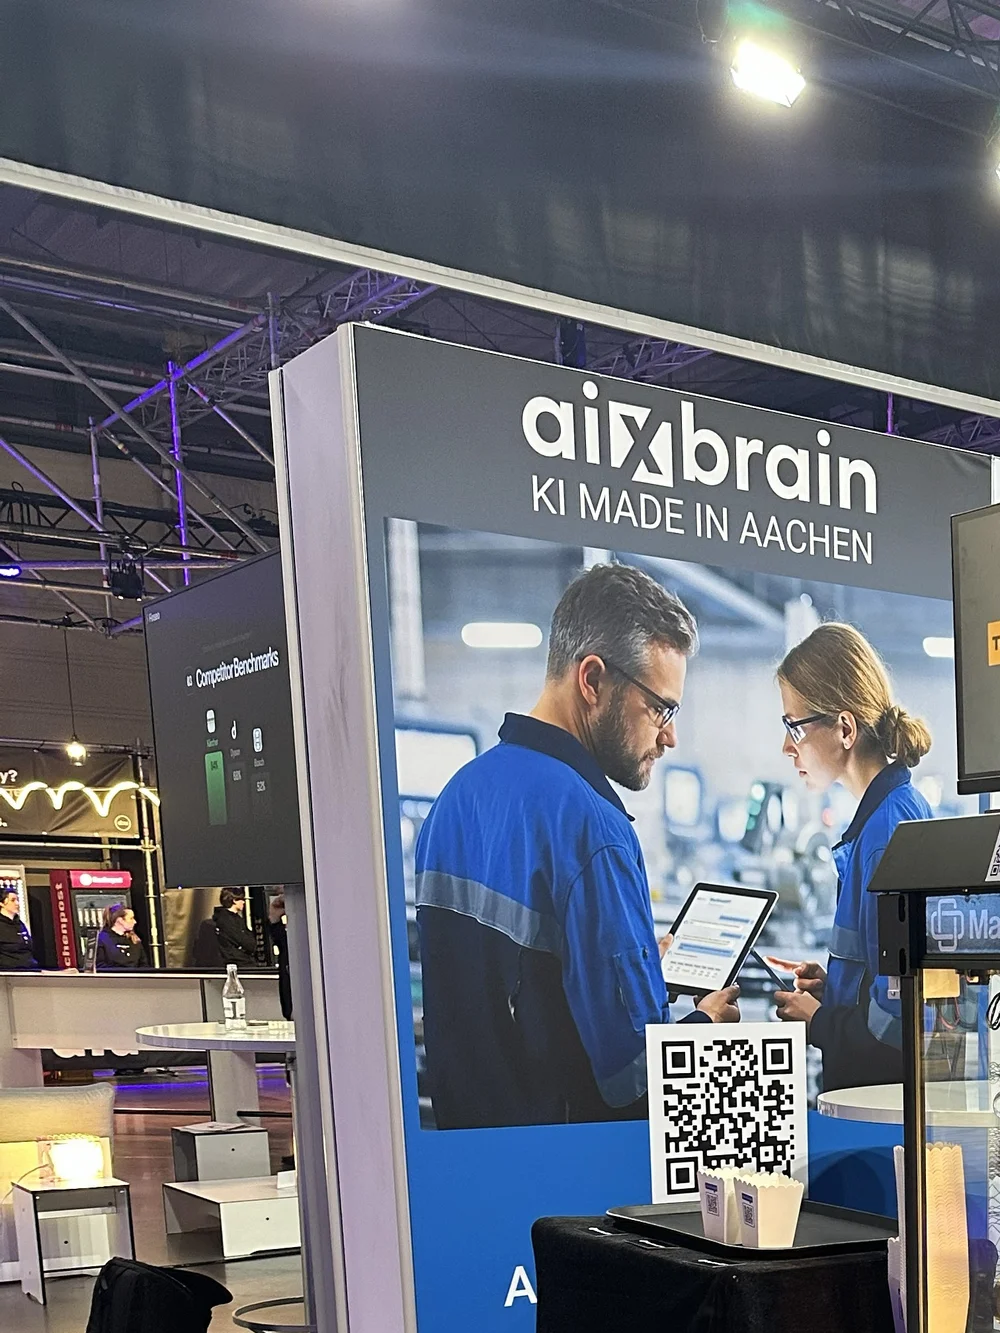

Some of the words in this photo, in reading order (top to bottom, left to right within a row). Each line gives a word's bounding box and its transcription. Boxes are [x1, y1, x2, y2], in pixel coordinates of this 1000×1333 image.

[532, 475, 566, 516] KI
[579, 483, 685, 535] MADE
[696, 502, 728, 541] IN
[739, 511, 873, 565] AACHEN
[196, 662, 234, 688] Competitor
[233, 647, 279, 677] Benchmarks
[55, 883, 71, 967] chenpost
